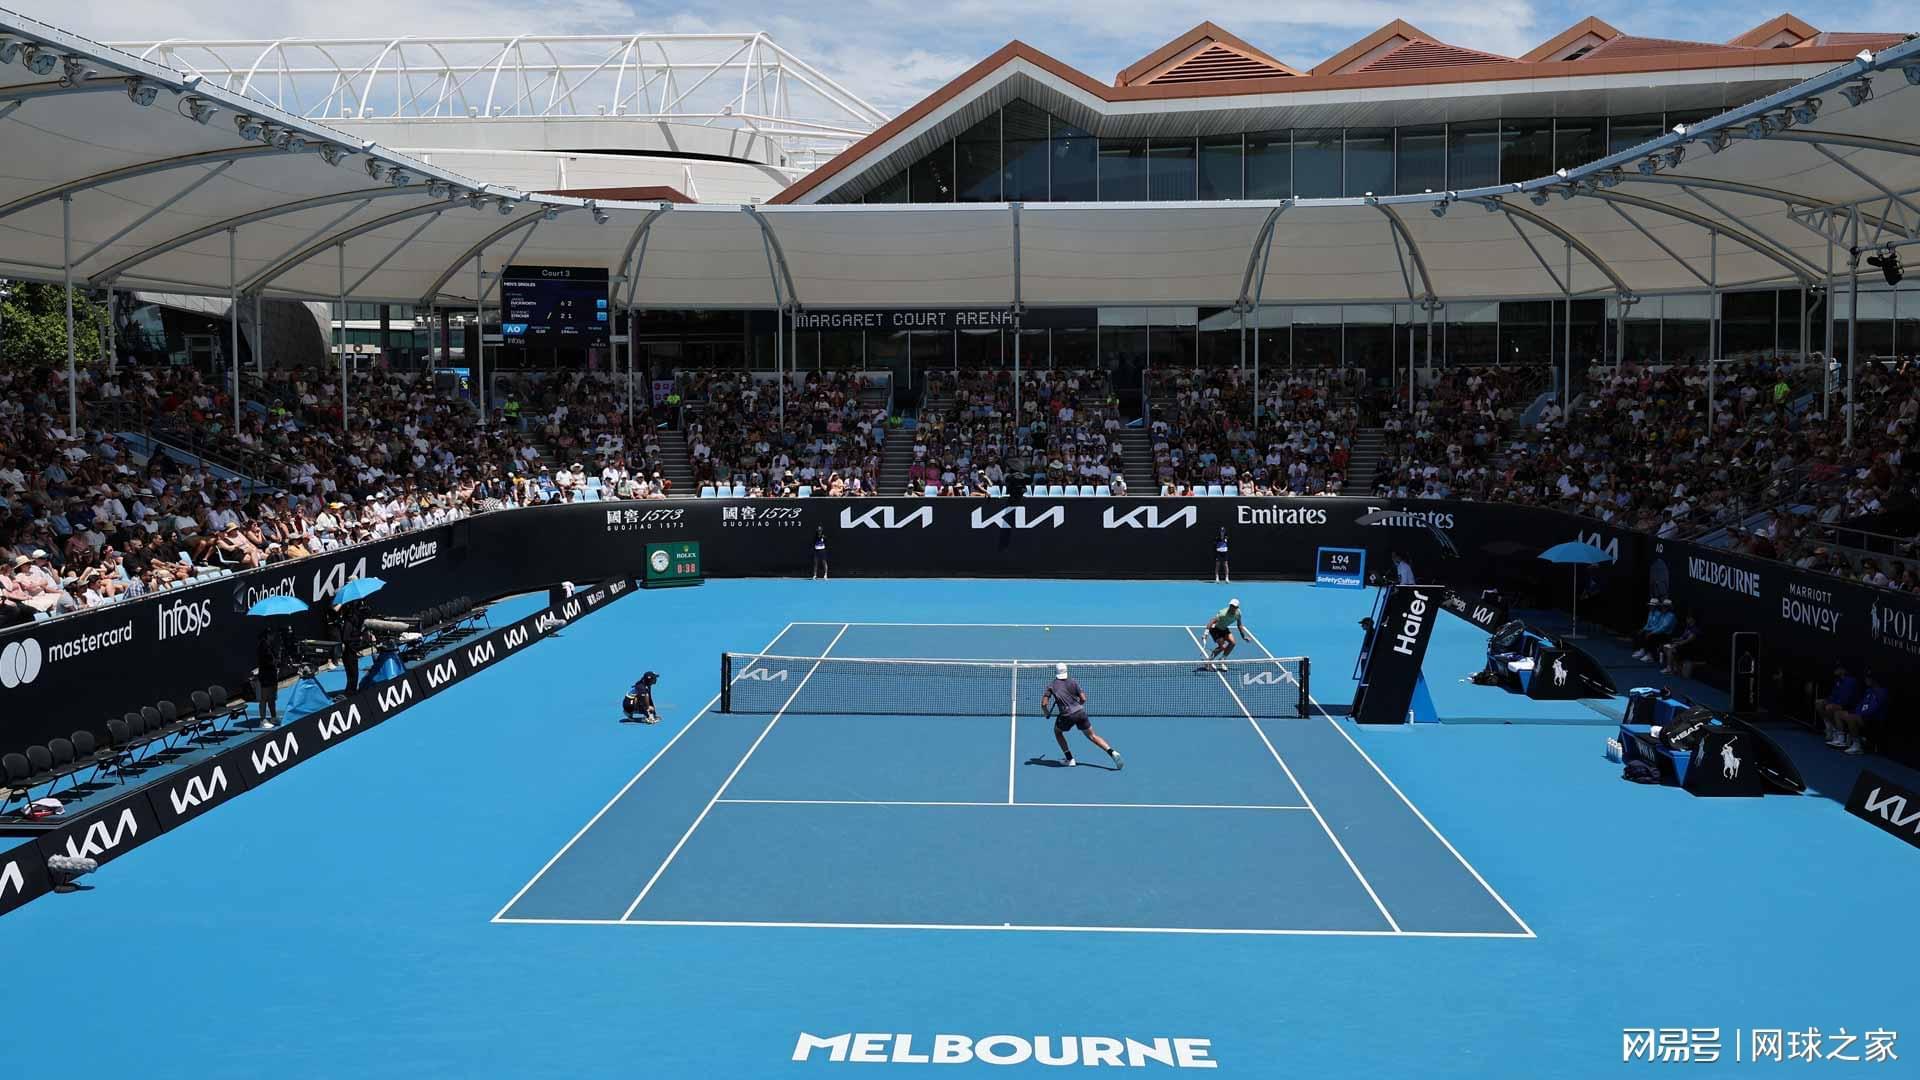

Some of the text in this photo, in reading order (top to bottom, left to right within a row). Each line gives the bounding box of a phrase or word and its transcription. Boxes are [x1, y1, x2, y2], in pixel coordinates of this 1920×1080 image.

[796, 312, 1012, 328] MARGARET COURT ARENA
[1237, 505, 1327, 524] Emirates
[381, 540, 437, 569] SafetyCulture
[1330, 555, 1349, 564] 194
[1317, 576, 1360, 585] SafetyCulture
[1688, 556, 1760, 598] MELBOURNE
[1789, 583, 1832, 604] MARRIOTT
[158, 599, 211, 641] Infosys
[1393, 590, 1428, 656] Haier
[1782, 598, 1840, 633] BONVOY
[49, 620, 132, 663] mastercard
[1670, 722, 1704, 744] HEAD
[792, 1031, 1218, 1068] MELBOURNE
